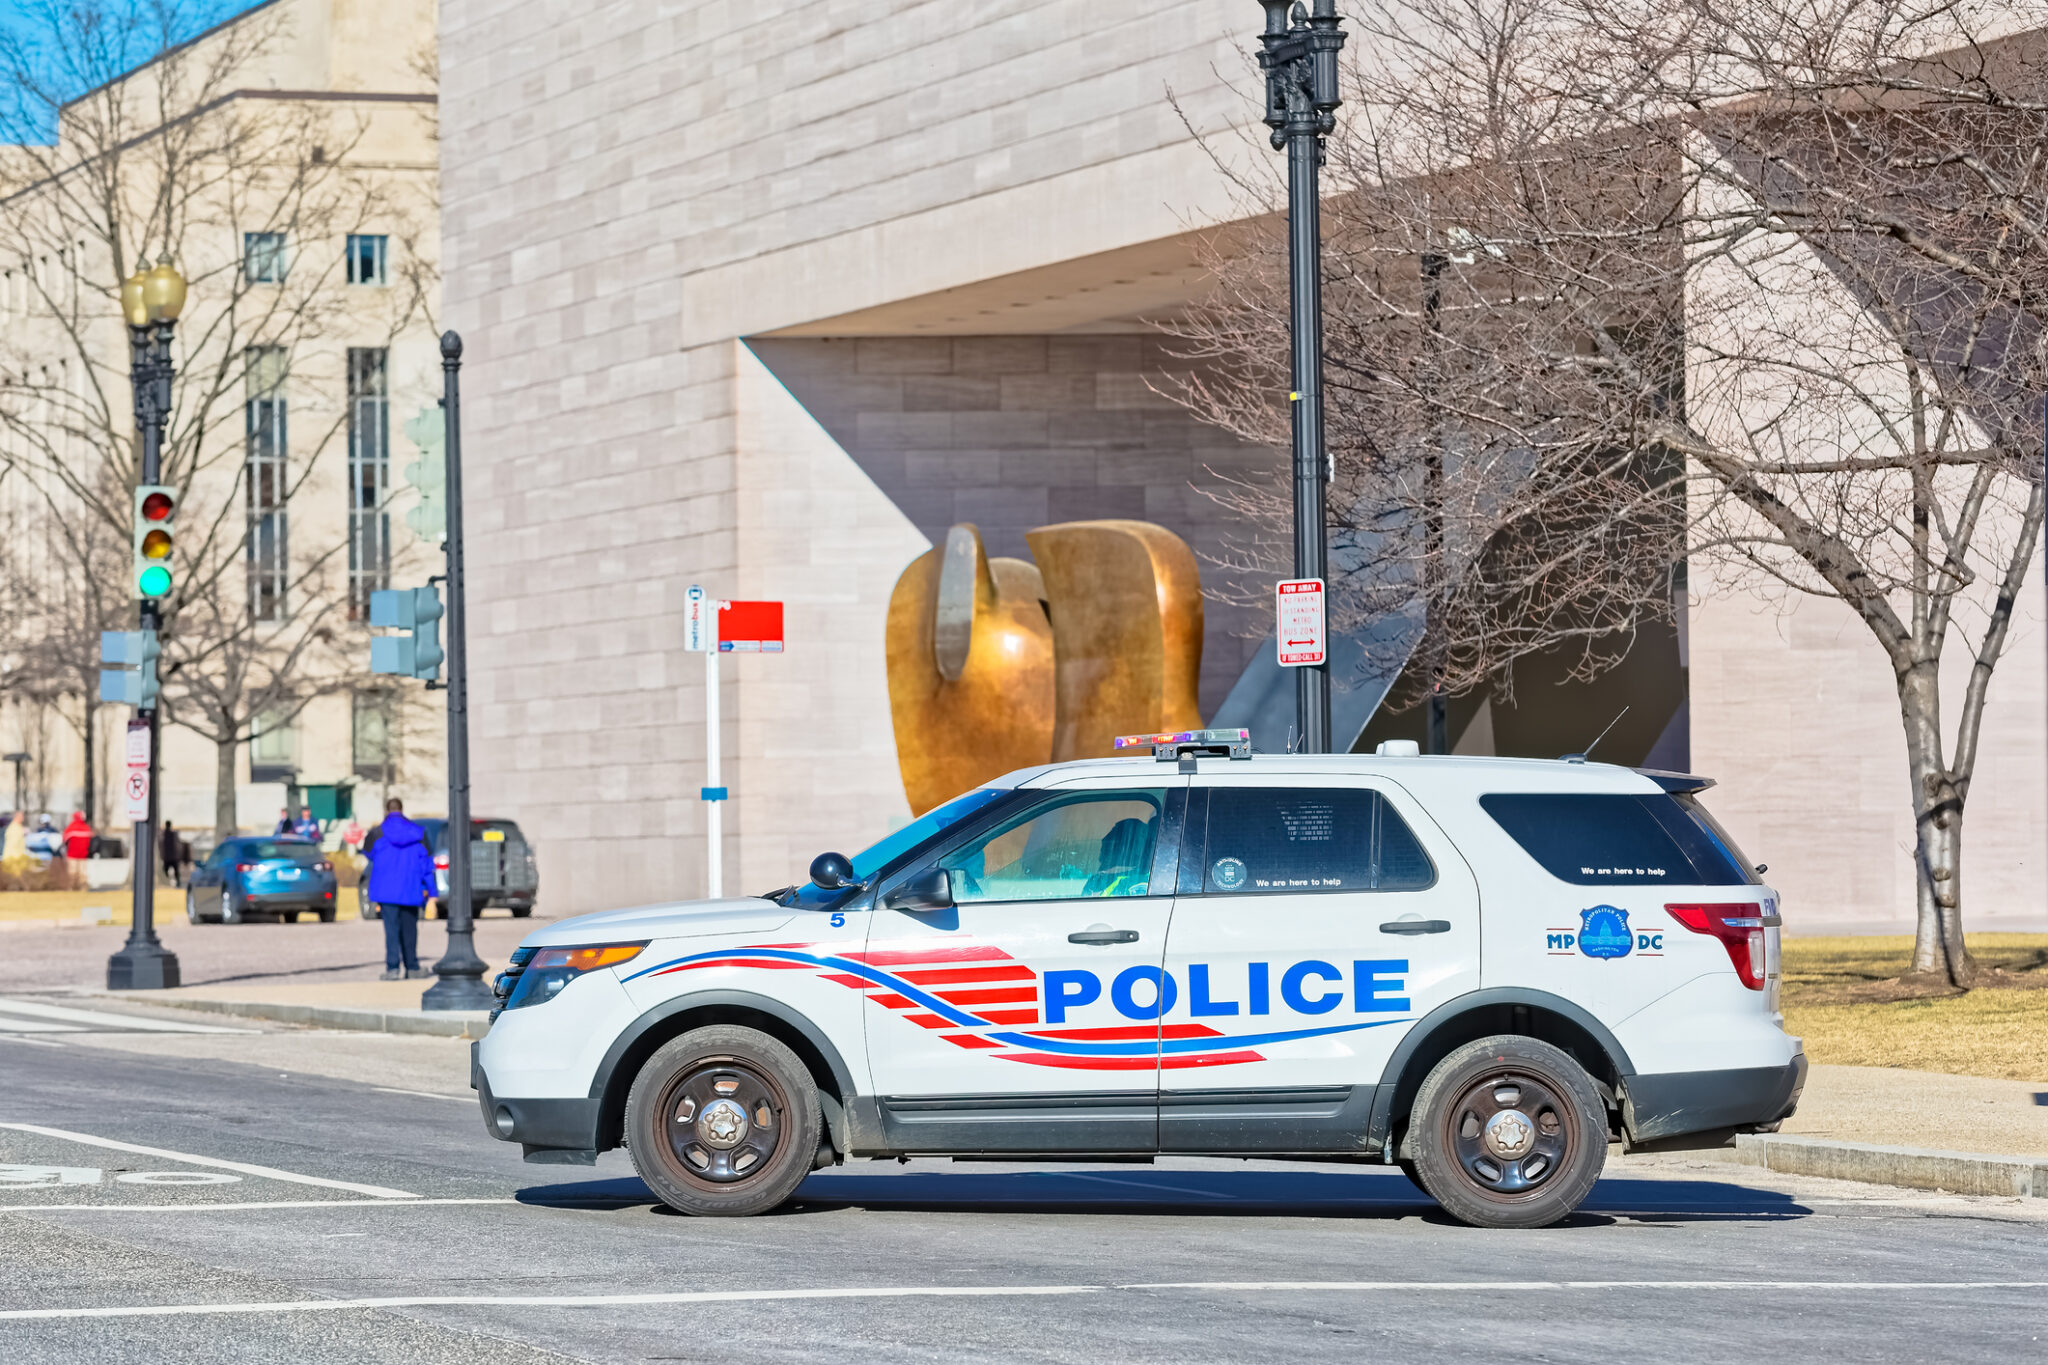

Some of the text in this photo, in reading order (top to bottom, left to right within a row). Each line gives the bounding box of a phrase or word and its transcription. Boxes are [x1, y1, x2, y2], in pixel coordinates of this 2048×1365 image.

[1283, 584, 1316, 593] TOW AWAY
[1581, 866, 1594, 875] We
[1614, 867, 1633, 875] here
[1636, 867, 1645, 875] to
[1647, 867, 1666, 877] help
[1256, 879, 1269, 887] We
[1289, 879, 1308, 887] here
[1311, 878, 1320, 886] to
[1323, 878, 1342, 887] help
[830, 913, 845, 928] 5
[1584, 907, 1627, 931] METROPOLITAN POLICE
[1546, 934, 1575, 949] MP
[1637, 935, 1663, 950] DC
[1043, 959, 1411, 1024] POLICE
[656, 1175, 768, 1209] GOODYEAR
